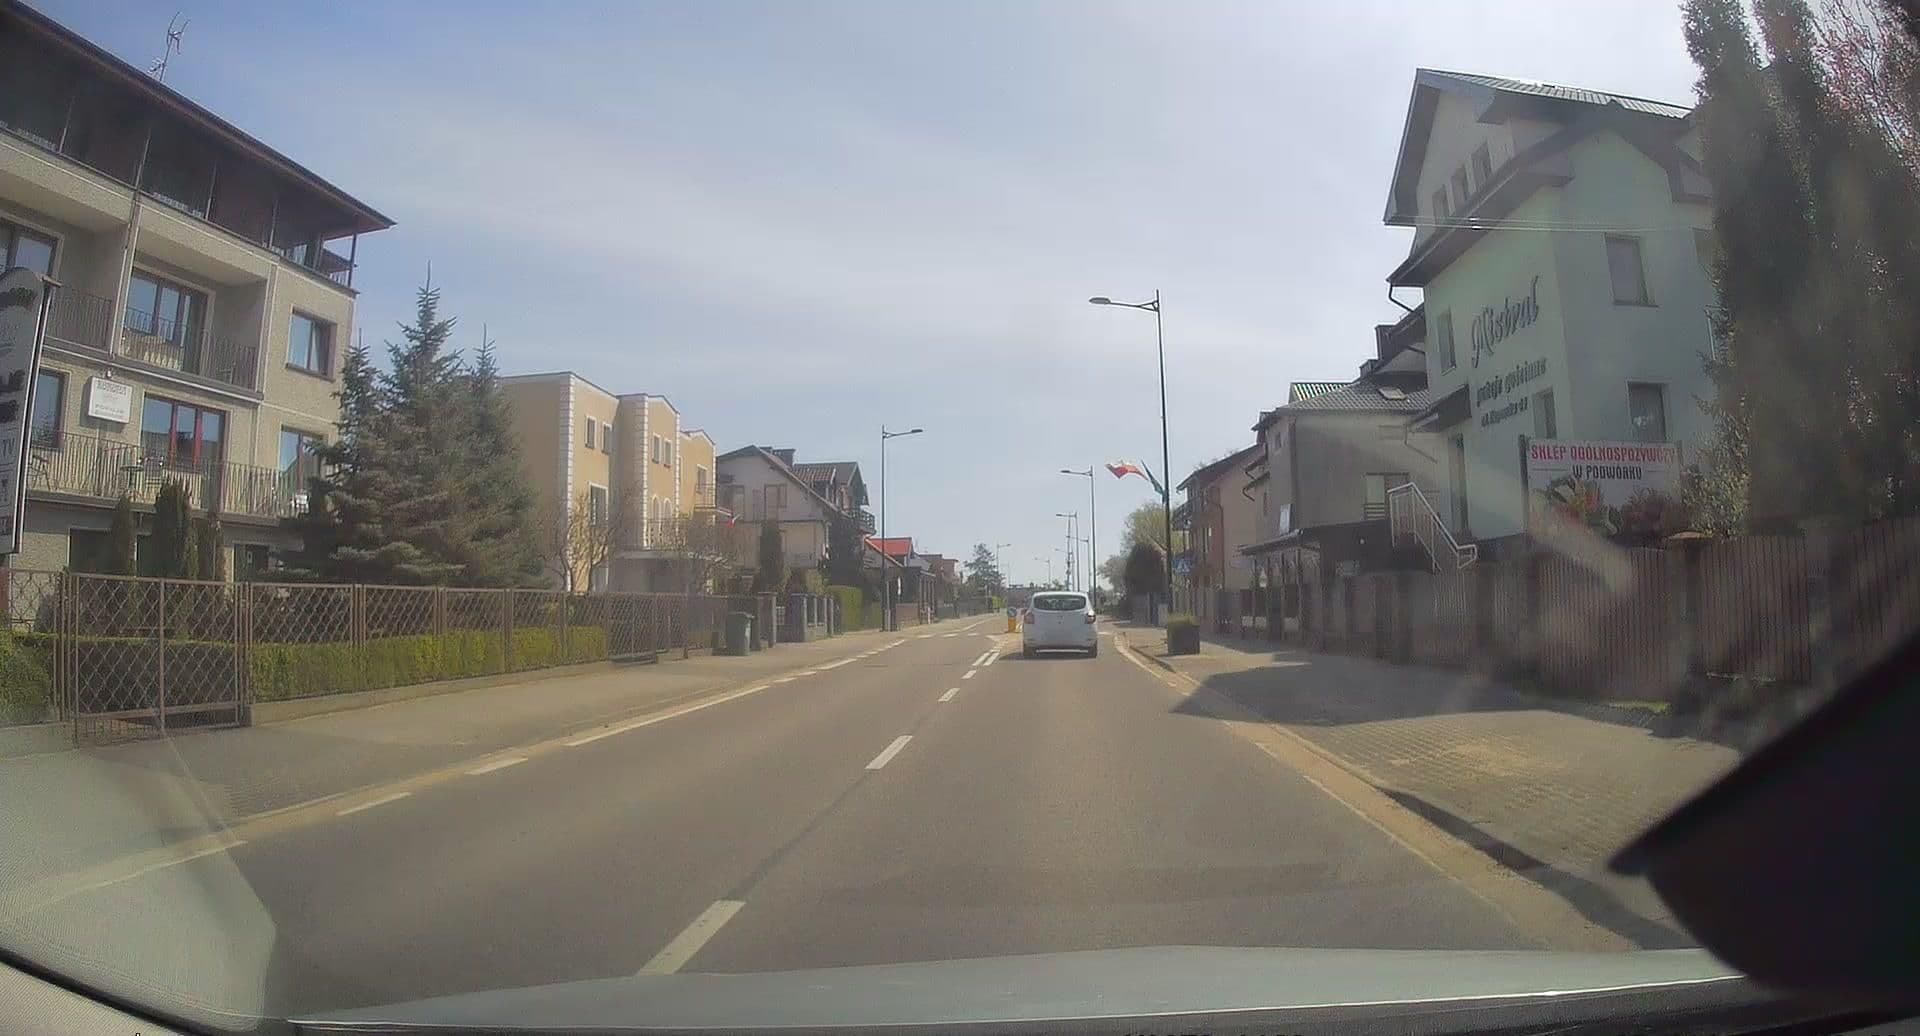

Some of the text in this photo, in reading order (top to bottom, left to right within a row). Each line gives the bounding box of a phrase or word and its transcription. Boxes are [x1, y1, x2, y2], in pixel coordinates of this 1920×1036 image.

[1471, 275, 1540, 369] Mistral
[1531, 444, 1567, 460] SKLEP
[1572, 464, 1583, 479] W
